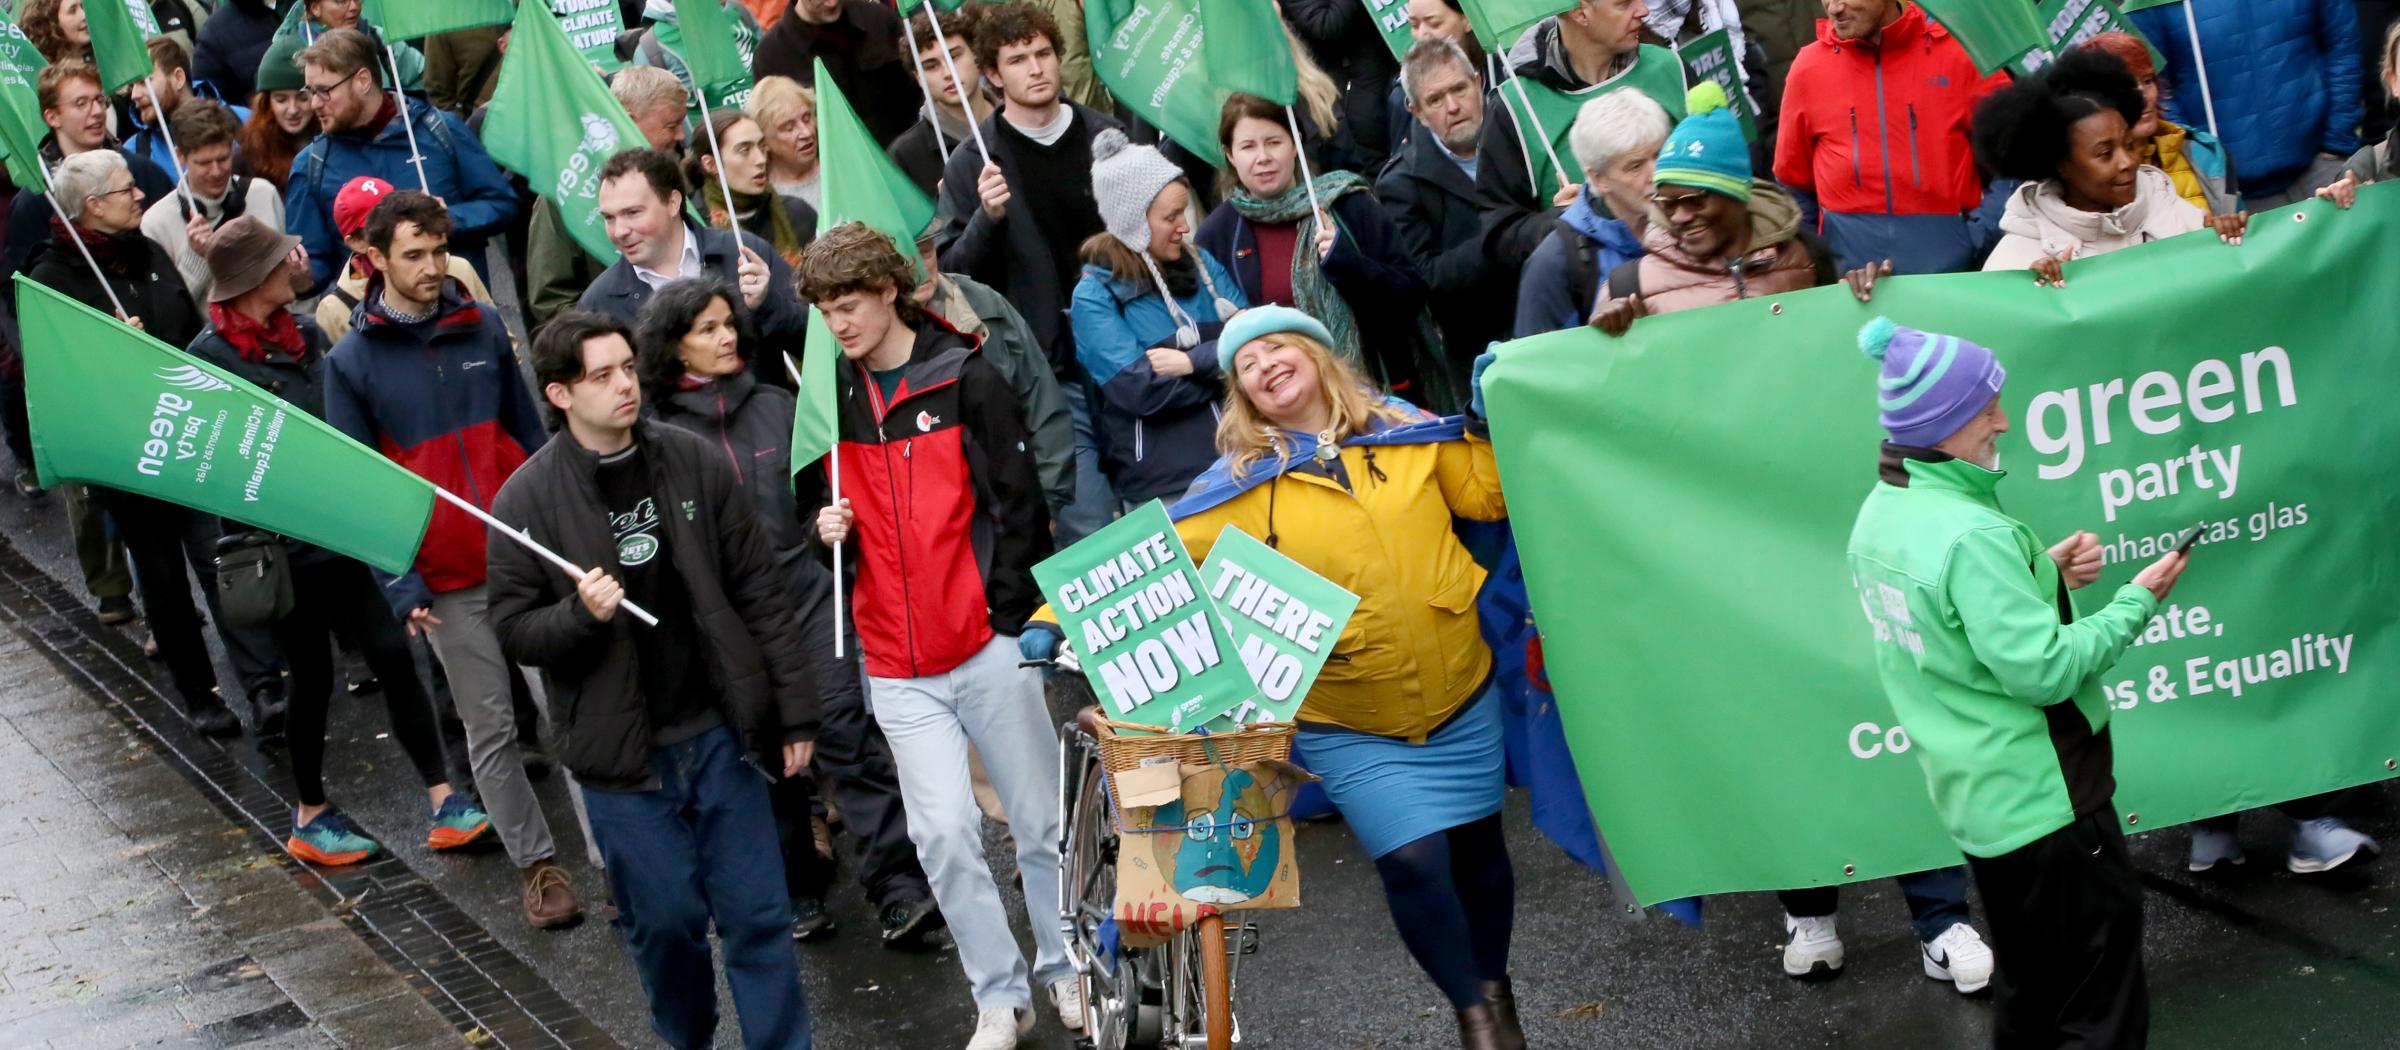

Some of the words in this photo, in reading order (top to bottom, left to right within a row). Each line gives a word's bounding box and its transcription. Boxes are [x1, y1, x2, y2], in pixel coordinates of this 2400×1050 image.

[562, 9, 616, 33] CLIMATE
[573, 26, 617, 49] ATURE
[2025, 345, 2297, 480] green
[2098, 443, 2242, 522] party
[2248, 501, 2309, 542] glas
[1058, 531, 1176, 613] CLIMATE
[1081, 568, 1196, 655] ACTION
[1211, 557, 1334, 654] THERE
[1098, 610, 1221, 715] NOW
[1240, 633, 1304, 701] NO
[2146, 664, 2178, 703] &
[2186, 633, 2354, 697] Equality
